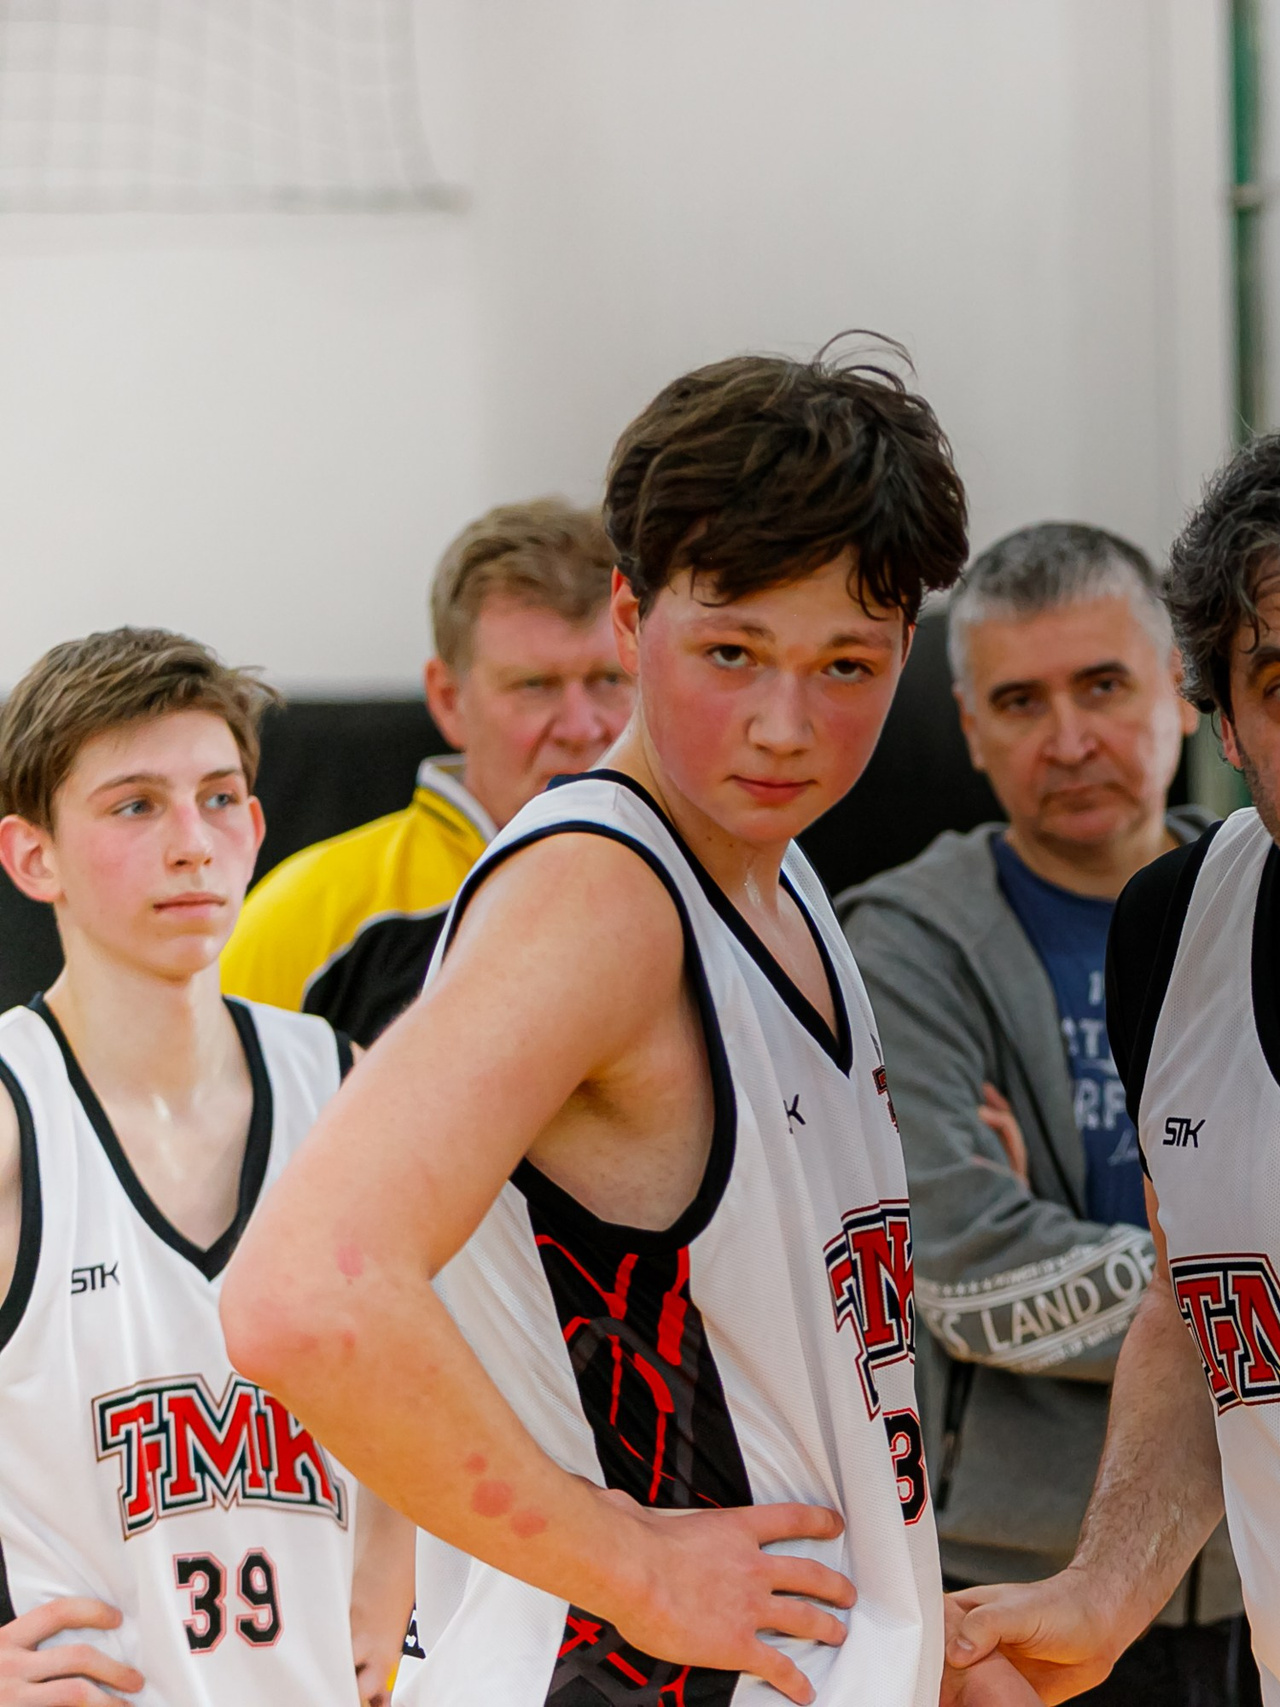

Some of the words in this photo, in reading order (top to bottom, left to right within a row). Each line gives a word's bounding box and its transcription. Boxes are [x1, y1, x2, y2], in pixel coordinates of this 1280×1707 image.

[1162, 1116, 1206, 1148] STK
[71, 1261, 119, 1295] STK
[981, 1276, 1100, 1351] LAND
[91, 1372, 349, 1541] TMK
[173, 1547, 284, 1655] 39
